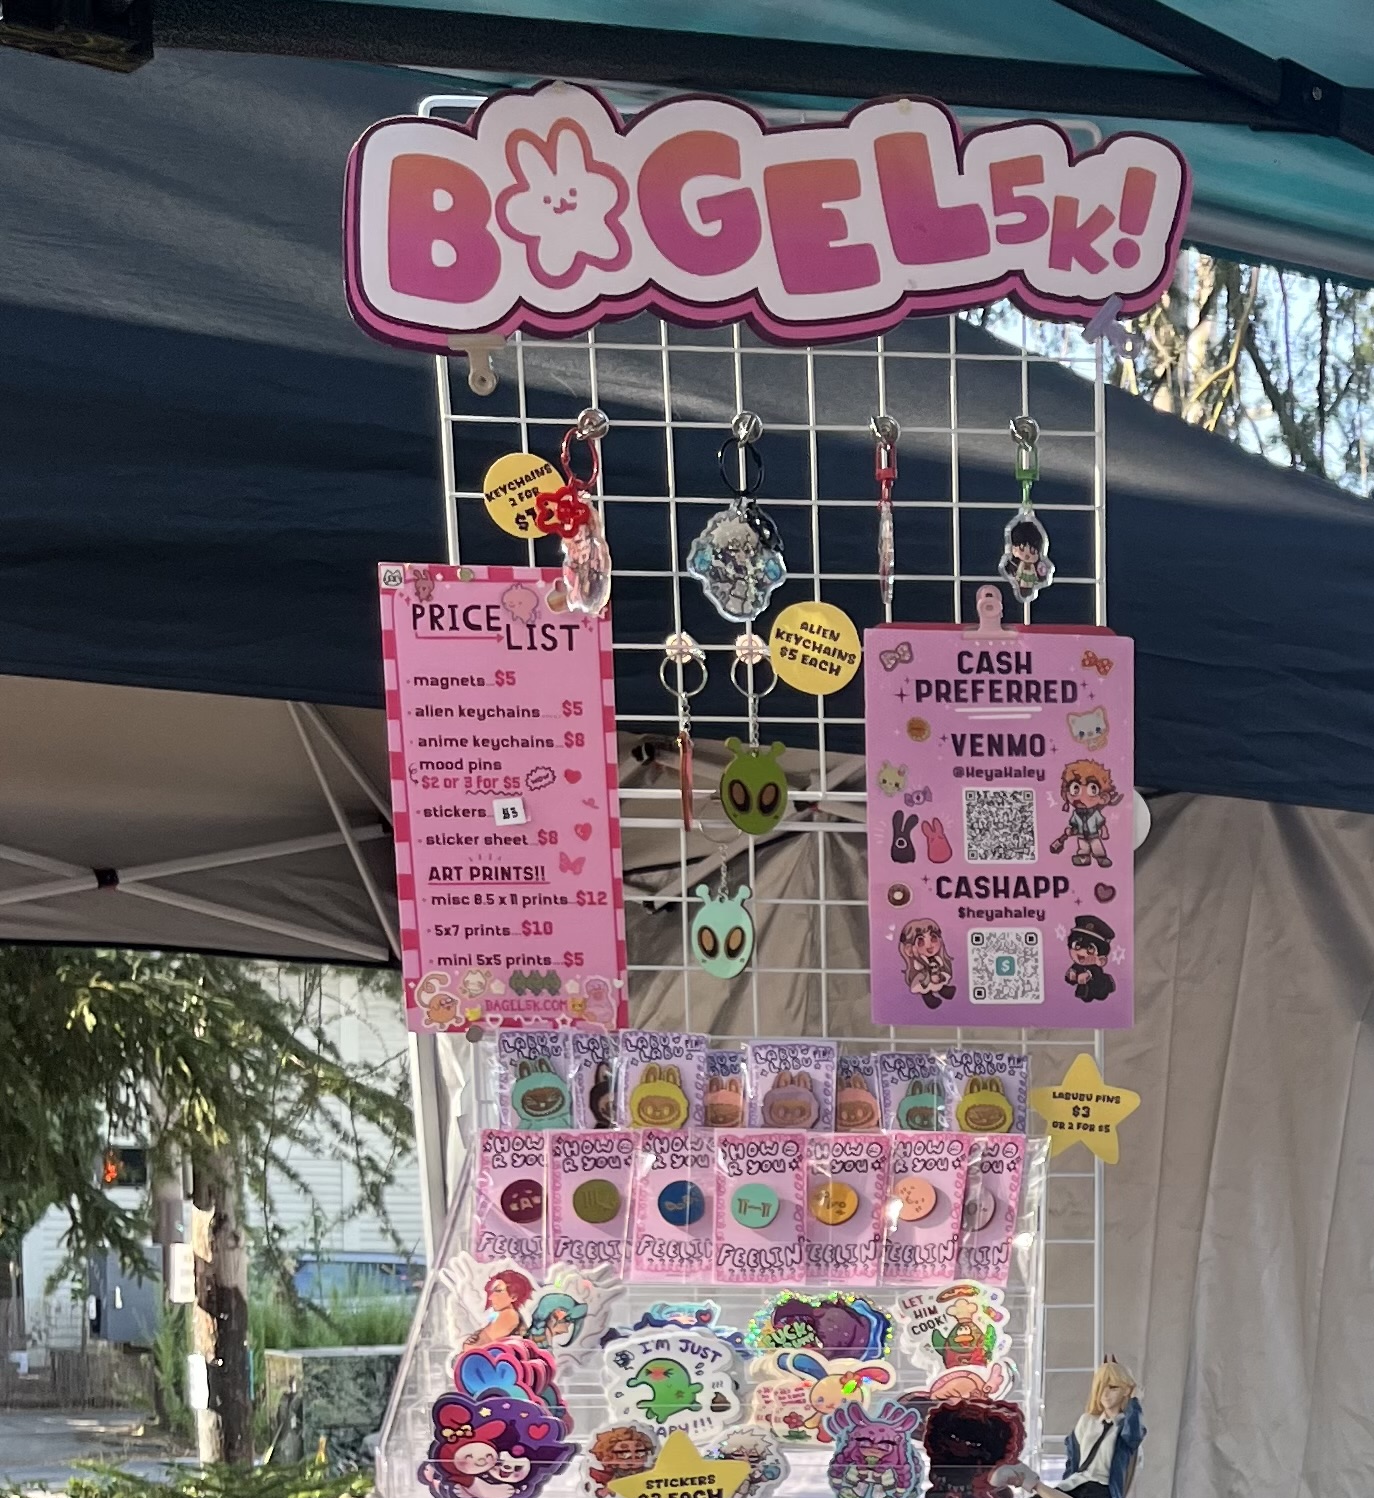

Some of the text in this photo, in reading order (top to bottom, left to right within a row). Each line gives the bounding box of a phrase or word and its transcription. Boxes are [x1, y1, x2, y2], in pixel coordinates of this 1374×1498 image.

[988, 154, 1155, 276] 5K!
[484, 463, 553, 502] KEYCHAINS
[518, 486, 540, 502] FOR
[412, 604, 580, 651] PRICE LIST
[800, 621, 840, 642] ALIEN
[775, 628, 857, 664] KEYCHAINS
[780, 646, 842, 676] $5 EACH
[957, 650, 1033, 675] CASH
[413, 669, 516, 690] magnets $5
[915, 679, 1078, 703] PREFERRED
[414, 700, 583, 721] alien keychains $5
[418, 731, 585, 751] anime keychains $8
[950, 733, 1046, 758] VENMO
[419, 758, 502, 775] mood pins
[953, 766, 1046, 781] @HeyaHaley
[421, 775, 440, 790] $2
[444, 778, 460, 789] or
[476, 776, 499, 789] for
[503, 776, 521, 790] $5
[423, 805, 487, 818] stickers
[426, 829, 559, 846] sticker sheet $8
[428, 865, 546, 882] ART PRINTS!!
[936, 875, 1069, 899] CASHAPP
[431, 894, 470, 905] misc
[498, 896, 507, 906] x
[522, 893, 568, 908] prints
[576, 890, 608, 907] $12
[958, 906, 1046, 921] $heyahaley
[434, 921, 553, 939] 5x7 prints $10
[437, 952, 584, 969] mini 5x5 prints $5
[1052, 1091, 1121, 1104] LABUBU PINS
[1072, 1105, 1090, 1118] $3
[1052, 1121, 1065, 1129] OR
[1076, 1122, 1095, 1132] FOR
[494, 1136, 544, 1153] HOW
[563, 1140, 613, 1157] HOW
[729, 1141, 779, 1160] HOW
[492, 1154, 507, 1168] R
[562, 1156, 621, 1172] R YOU
[747, 1159, 786, 1175] YOU
[831, 1160, 868, 1173] YOU
[912, 1158, 949, 1173] YOU
[902, 1295, 923, 1309] LET
[913, 1305, 939, 1319] HIM
[911, 1314, 948, 1335] COOK!
[638, 1339, 722, 1363] I'M JUST
[646, 1474, 716, 1489] STICKERS
